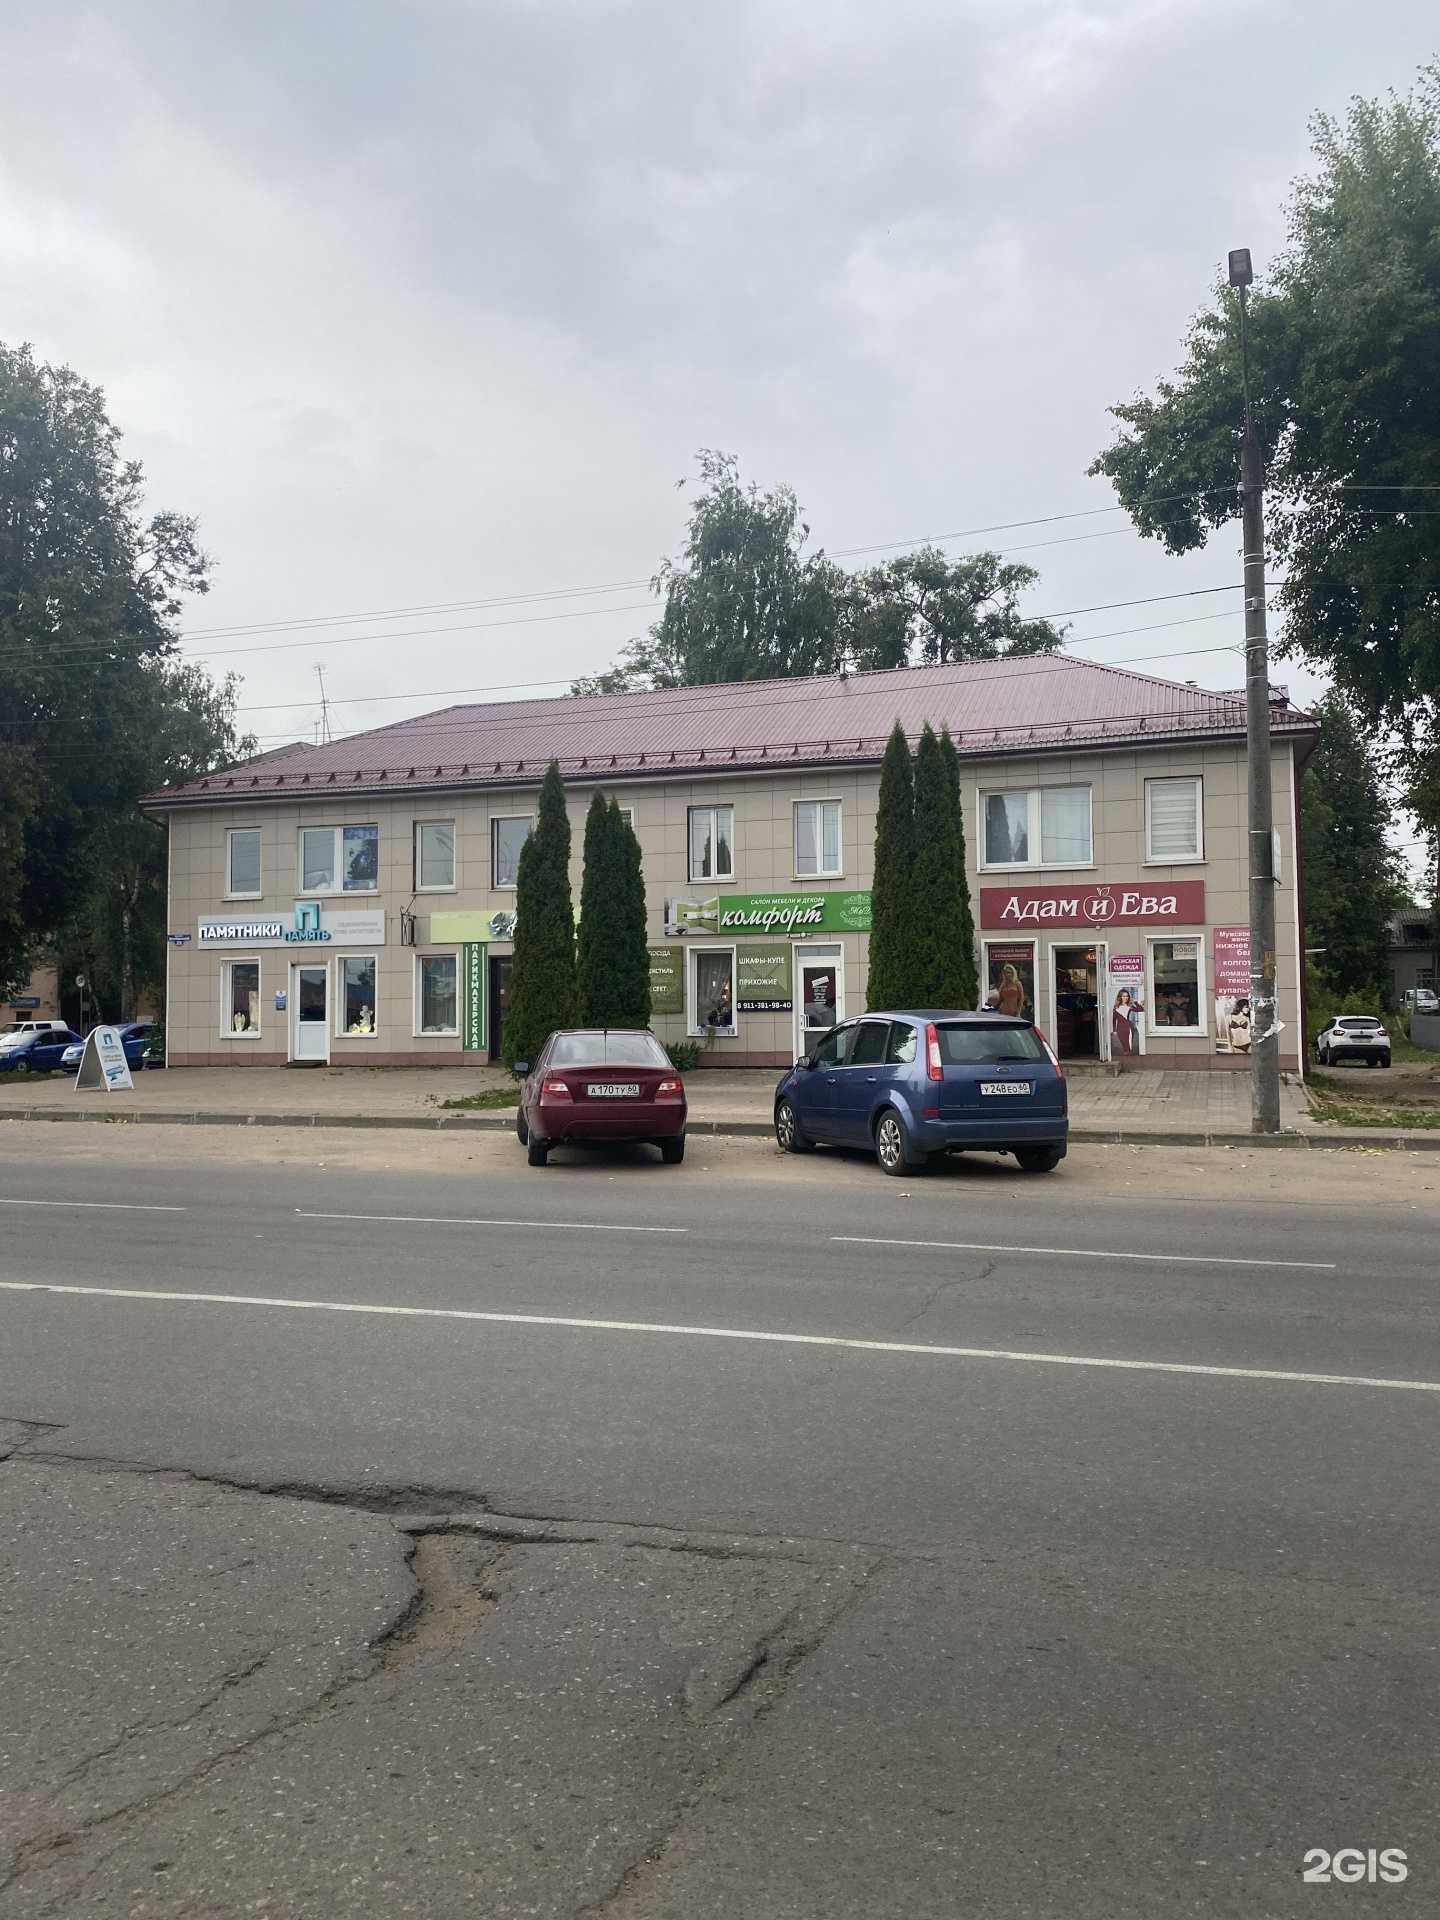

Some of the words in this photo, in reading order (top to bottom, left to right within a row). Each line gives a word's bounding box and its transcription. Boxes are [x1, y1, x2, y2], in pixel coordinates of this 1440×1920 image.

[720, 903, 825, 933] комфорт
[999, 896, 1080, 922] Адам
[1090, 899, 1109, 916] и
[1119, 892, 1178, 916] Ева
[199, 924, 282, 939] ПАМЯТНИКИ
[286, 930, 331, 942] ПАМЯТЬ
[471, 944, 480, 1049] ПАРИКМАХЕРСКАЯ
